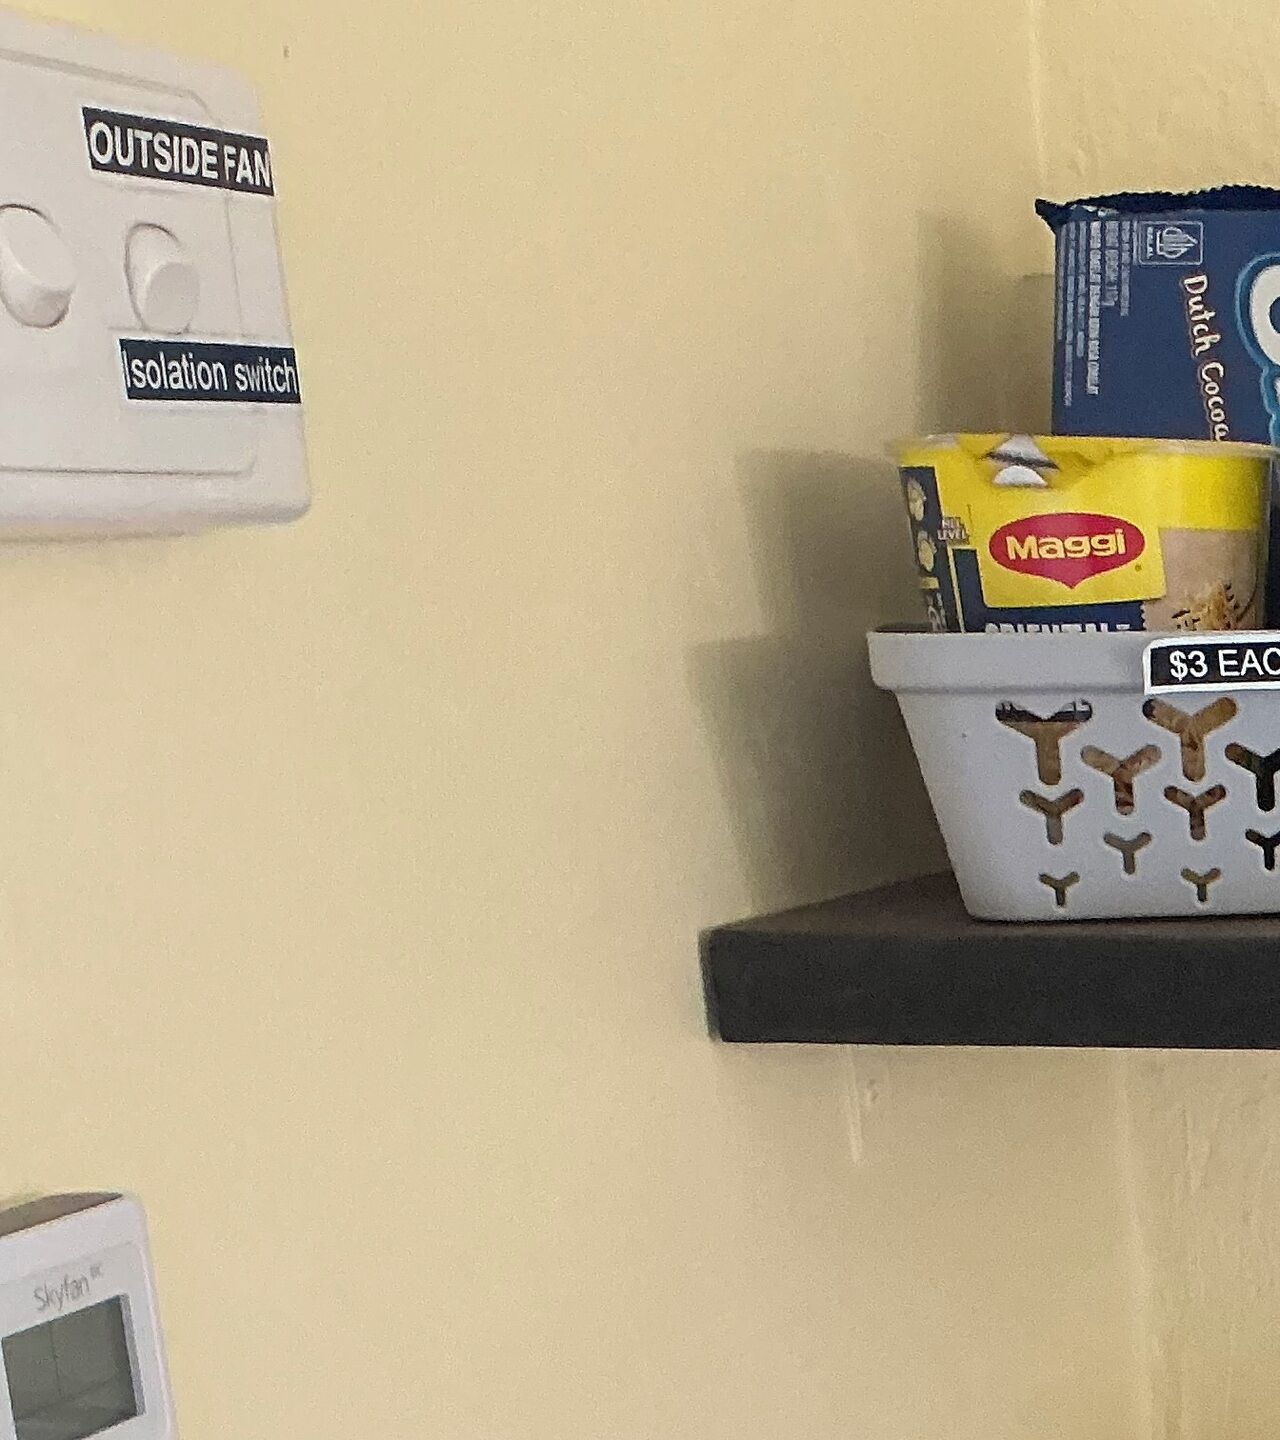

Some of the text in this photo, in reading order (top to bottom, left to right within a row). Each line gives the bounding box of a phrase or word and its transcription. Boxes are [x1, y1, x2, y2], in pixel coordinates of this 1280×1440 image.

[89, 122, 272, 188] OUTSIDE FAN
[122, 348, 298, 395] Isolation switch
[1183, 272, 1231, 442] Dutch Cocoa
[1006, 528, 1127, 561] Maggi
[1169, 649, 1207, 682] $3
[33, 1272, 92, 1312] Skyfan
